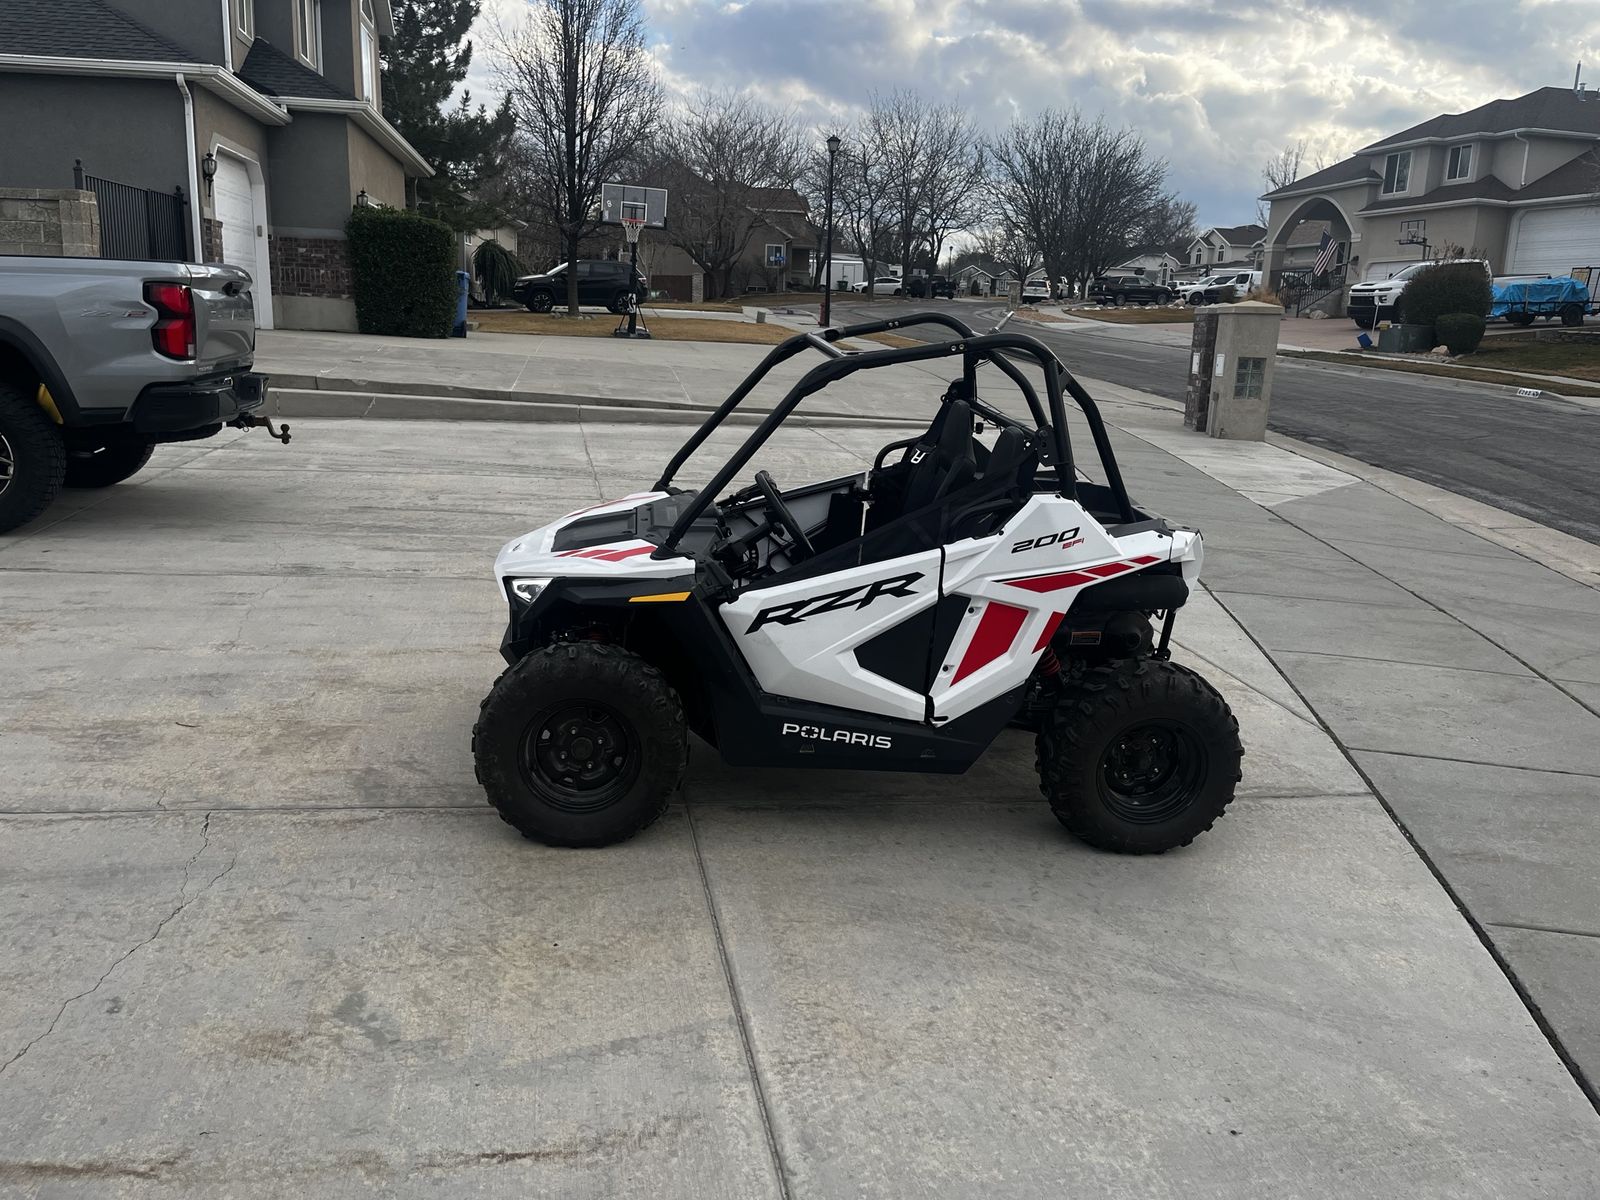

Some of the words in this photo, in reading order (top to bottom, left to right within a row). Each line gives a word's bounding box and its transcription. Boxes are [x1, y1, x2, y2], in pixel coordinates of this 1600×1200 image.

[1011, 526, 1080, 554] 200
[1062, 537, 1085, 550] EFI
[744, 571, 926, 635] RZR
[782, 723, 892, 749] POLARIS
